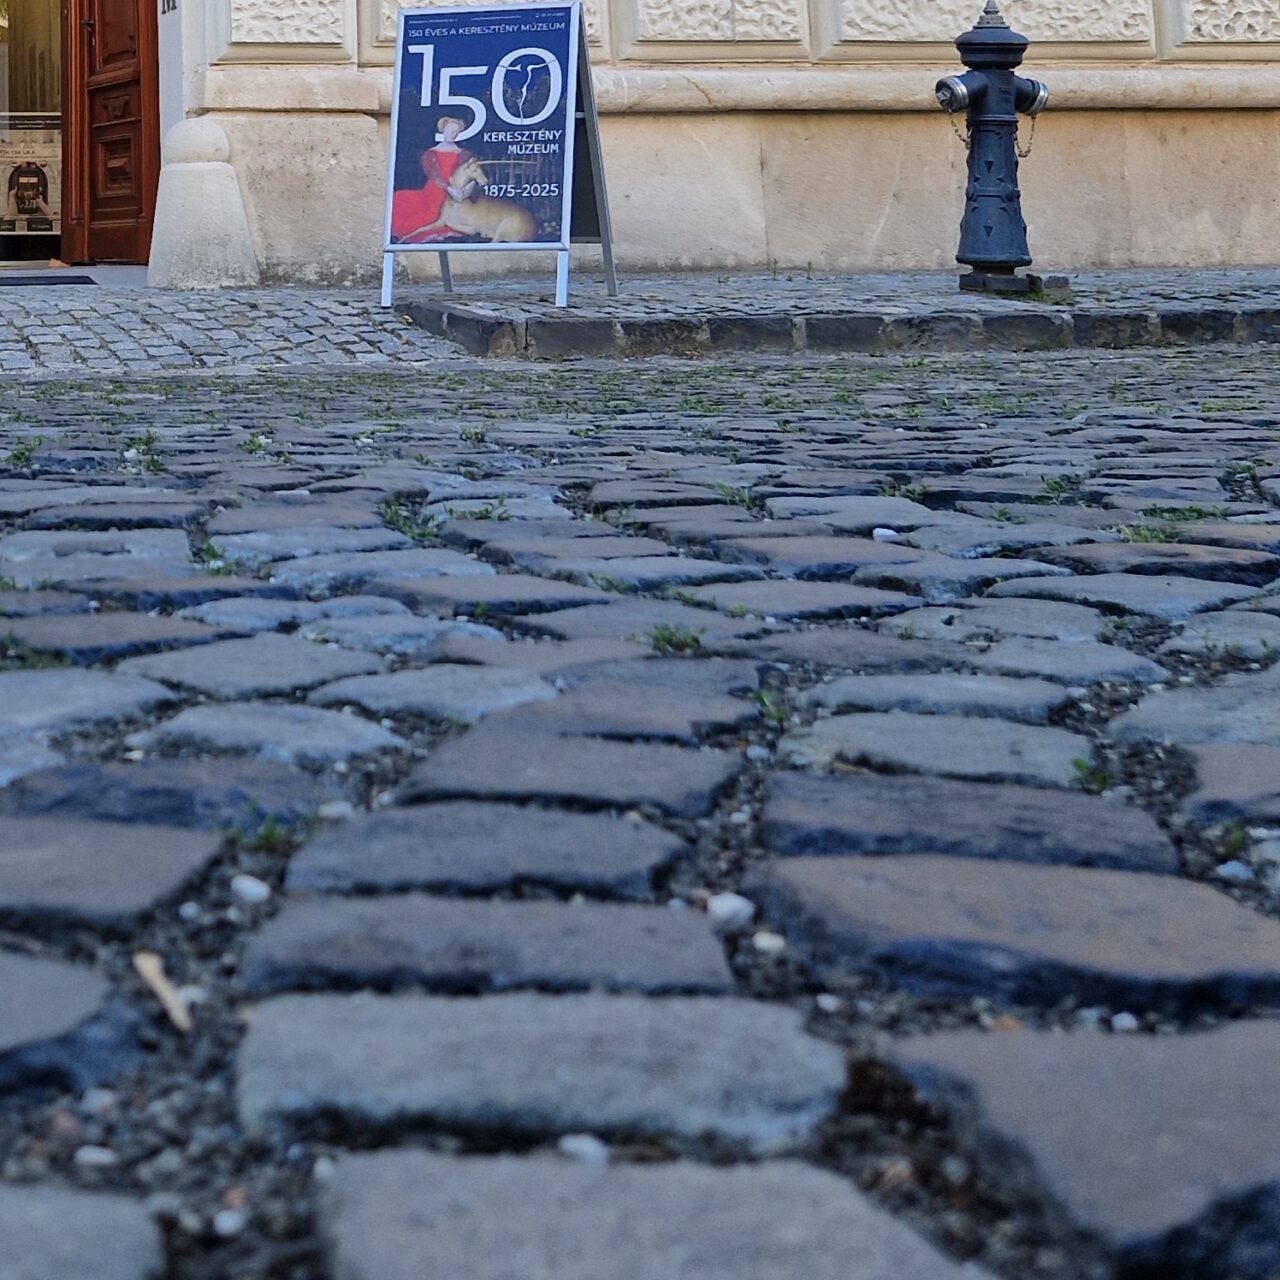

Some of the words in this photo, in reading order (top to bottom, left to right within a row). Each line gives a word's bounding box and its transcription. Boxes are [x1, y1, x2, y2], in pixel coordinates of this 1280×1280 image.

[408, 29, 423, 37] 150
[424, 26, 448, 36] ÉVES
[449, 27, 457, 35] A
[458, 23, 519, 35] KERESZTÉNY
[521, 22, 565, 31] MÚZEUM
[407, 44, 562, 142] 150
[483, 128, 563, 143] KERESZTÉNY
[507, 142, 559, 154] MÚZEUM
[483, 184, 559, 197] 1875-2025
